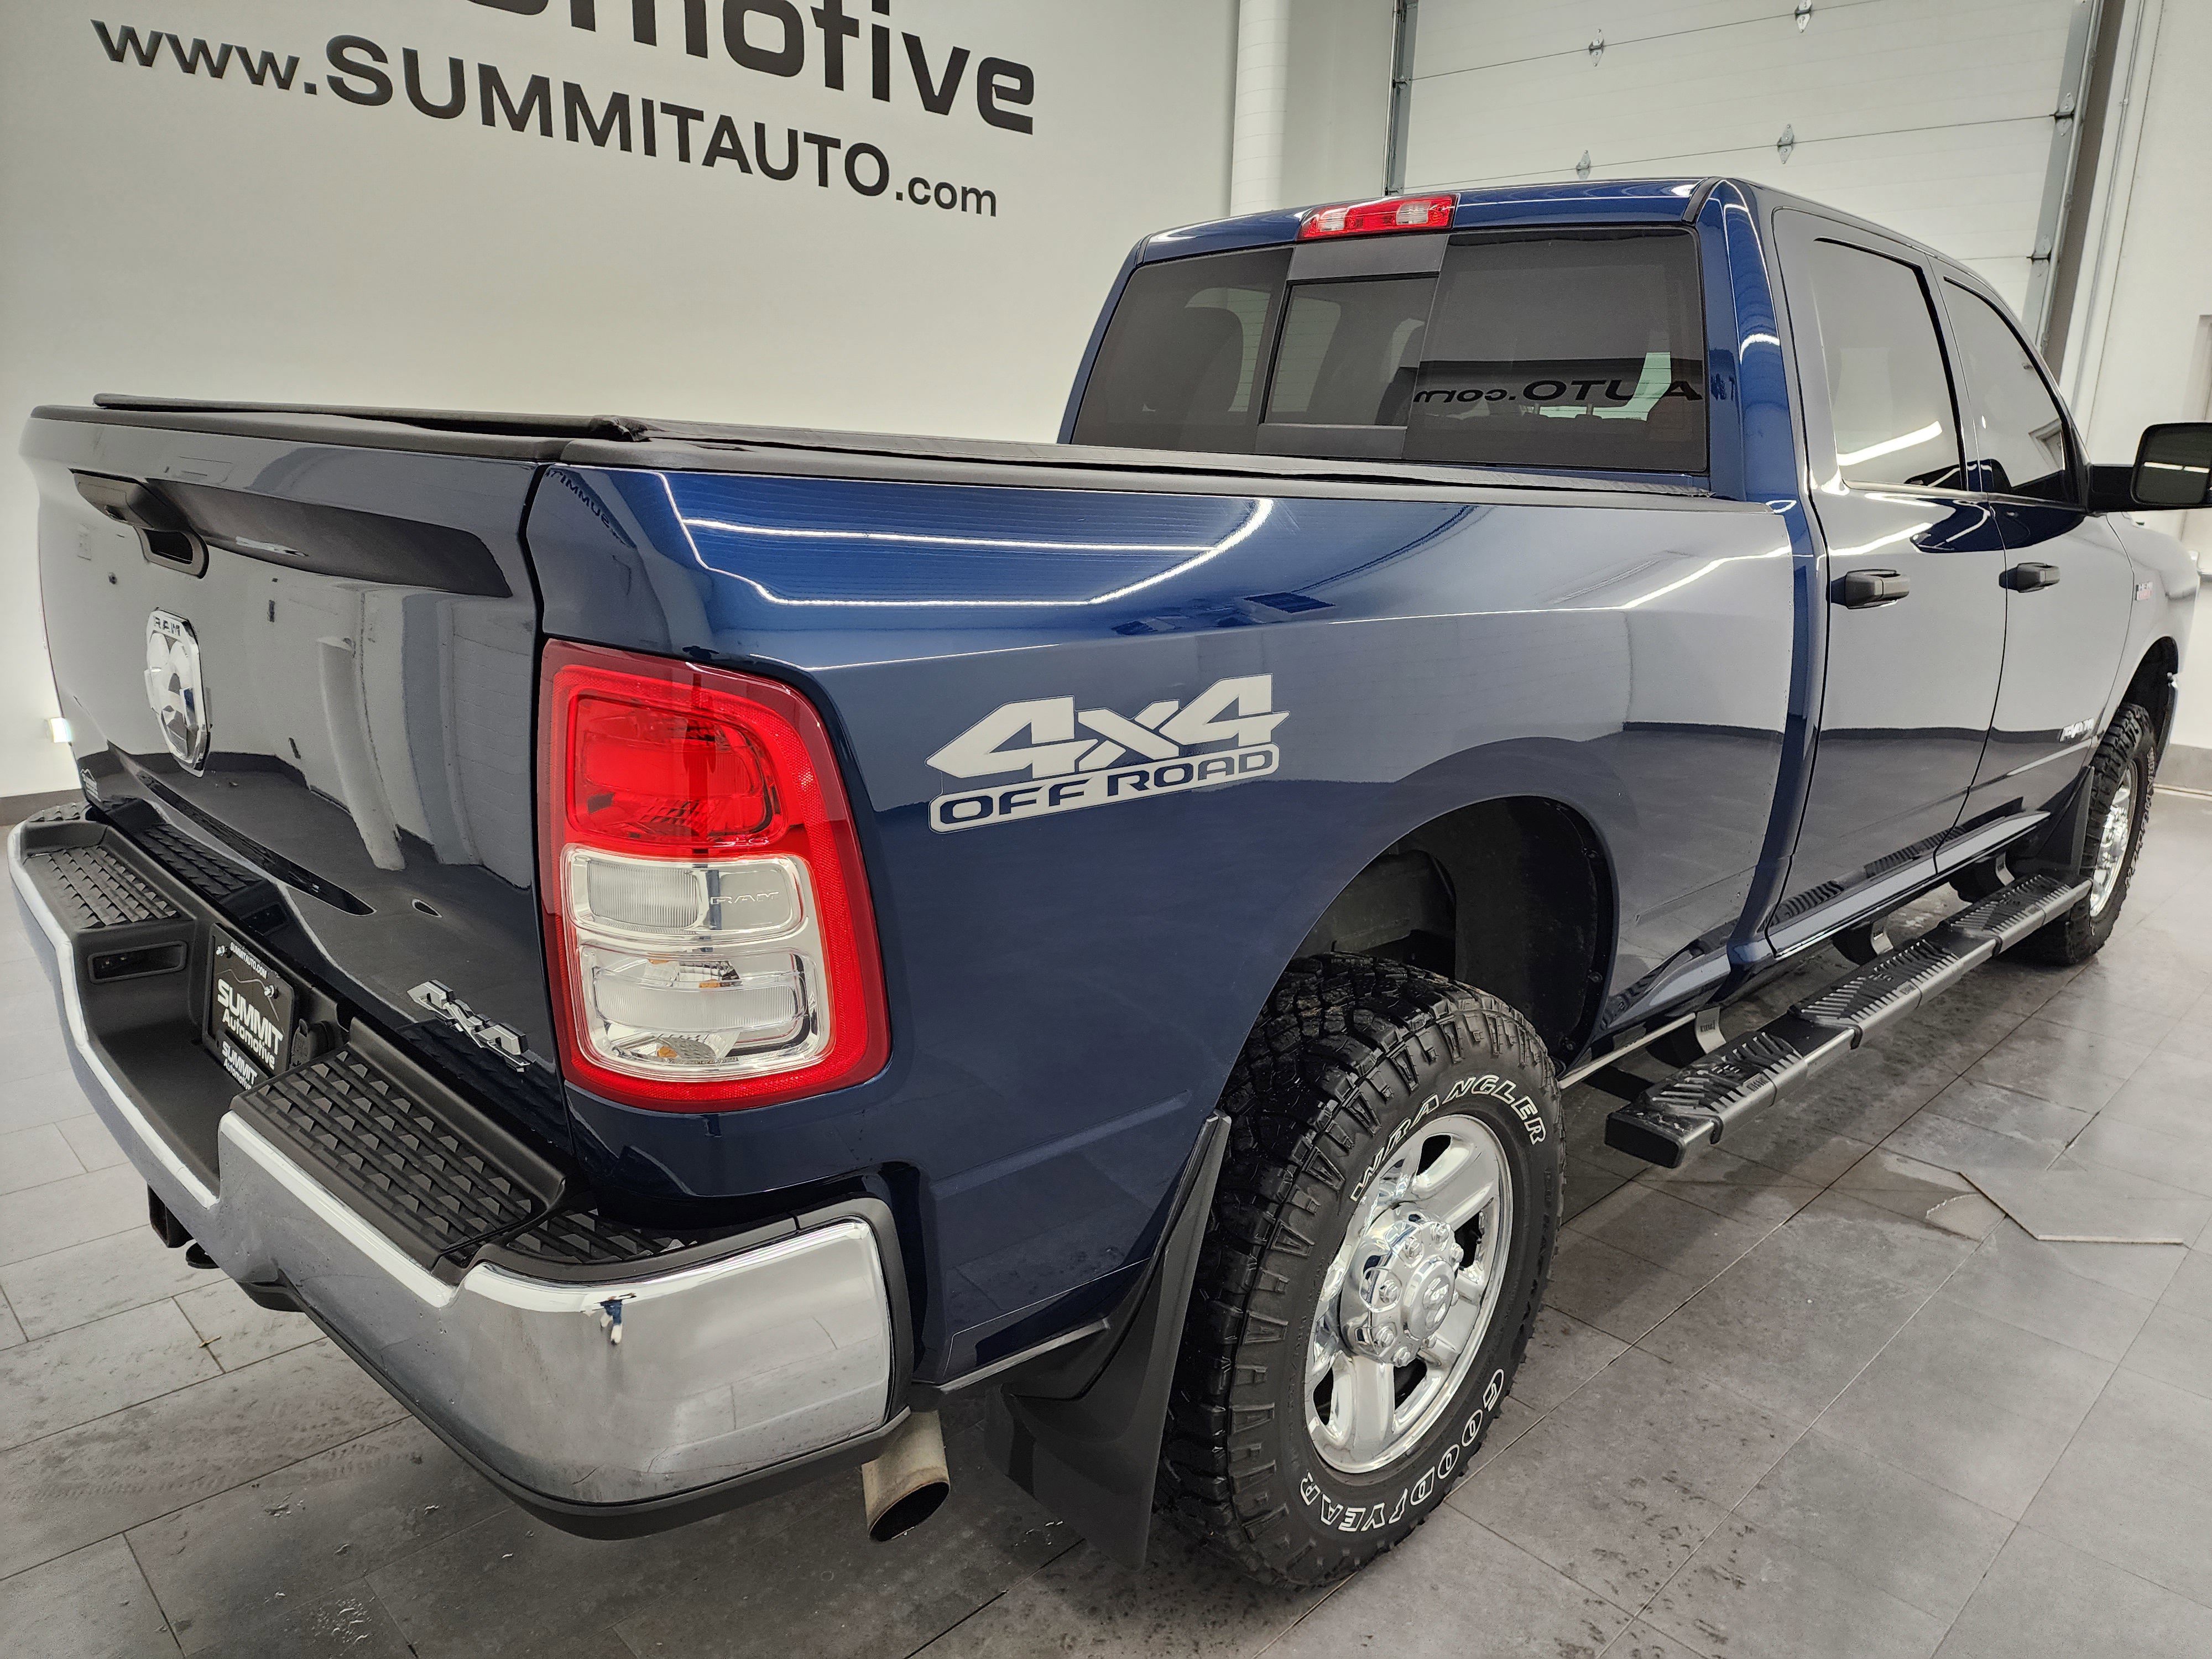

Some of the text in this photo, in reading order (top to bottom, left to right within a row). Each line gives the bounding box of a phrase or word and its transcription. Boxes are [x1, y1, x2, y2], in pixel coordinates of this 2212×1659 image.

[90, 20, 997, 217] www.SUMMITAUTO.com
[152, 615, 181, 637] RAM
[940, 750, 1273, 825] OFF ROAD
[710, 891, 779, 905] RAM
[230, 942, 267, 979] SUMMITAUTO.COM
[217, 978, 283, 1055] SUMMIT
[222, 1008, 275, 1070] Automotive
[222, 1041, 258, 1085] SUMMIT
[223, 1057, 252, 1090] Automotive
[1350, 1074, 1546, 1202] WRANGLER
